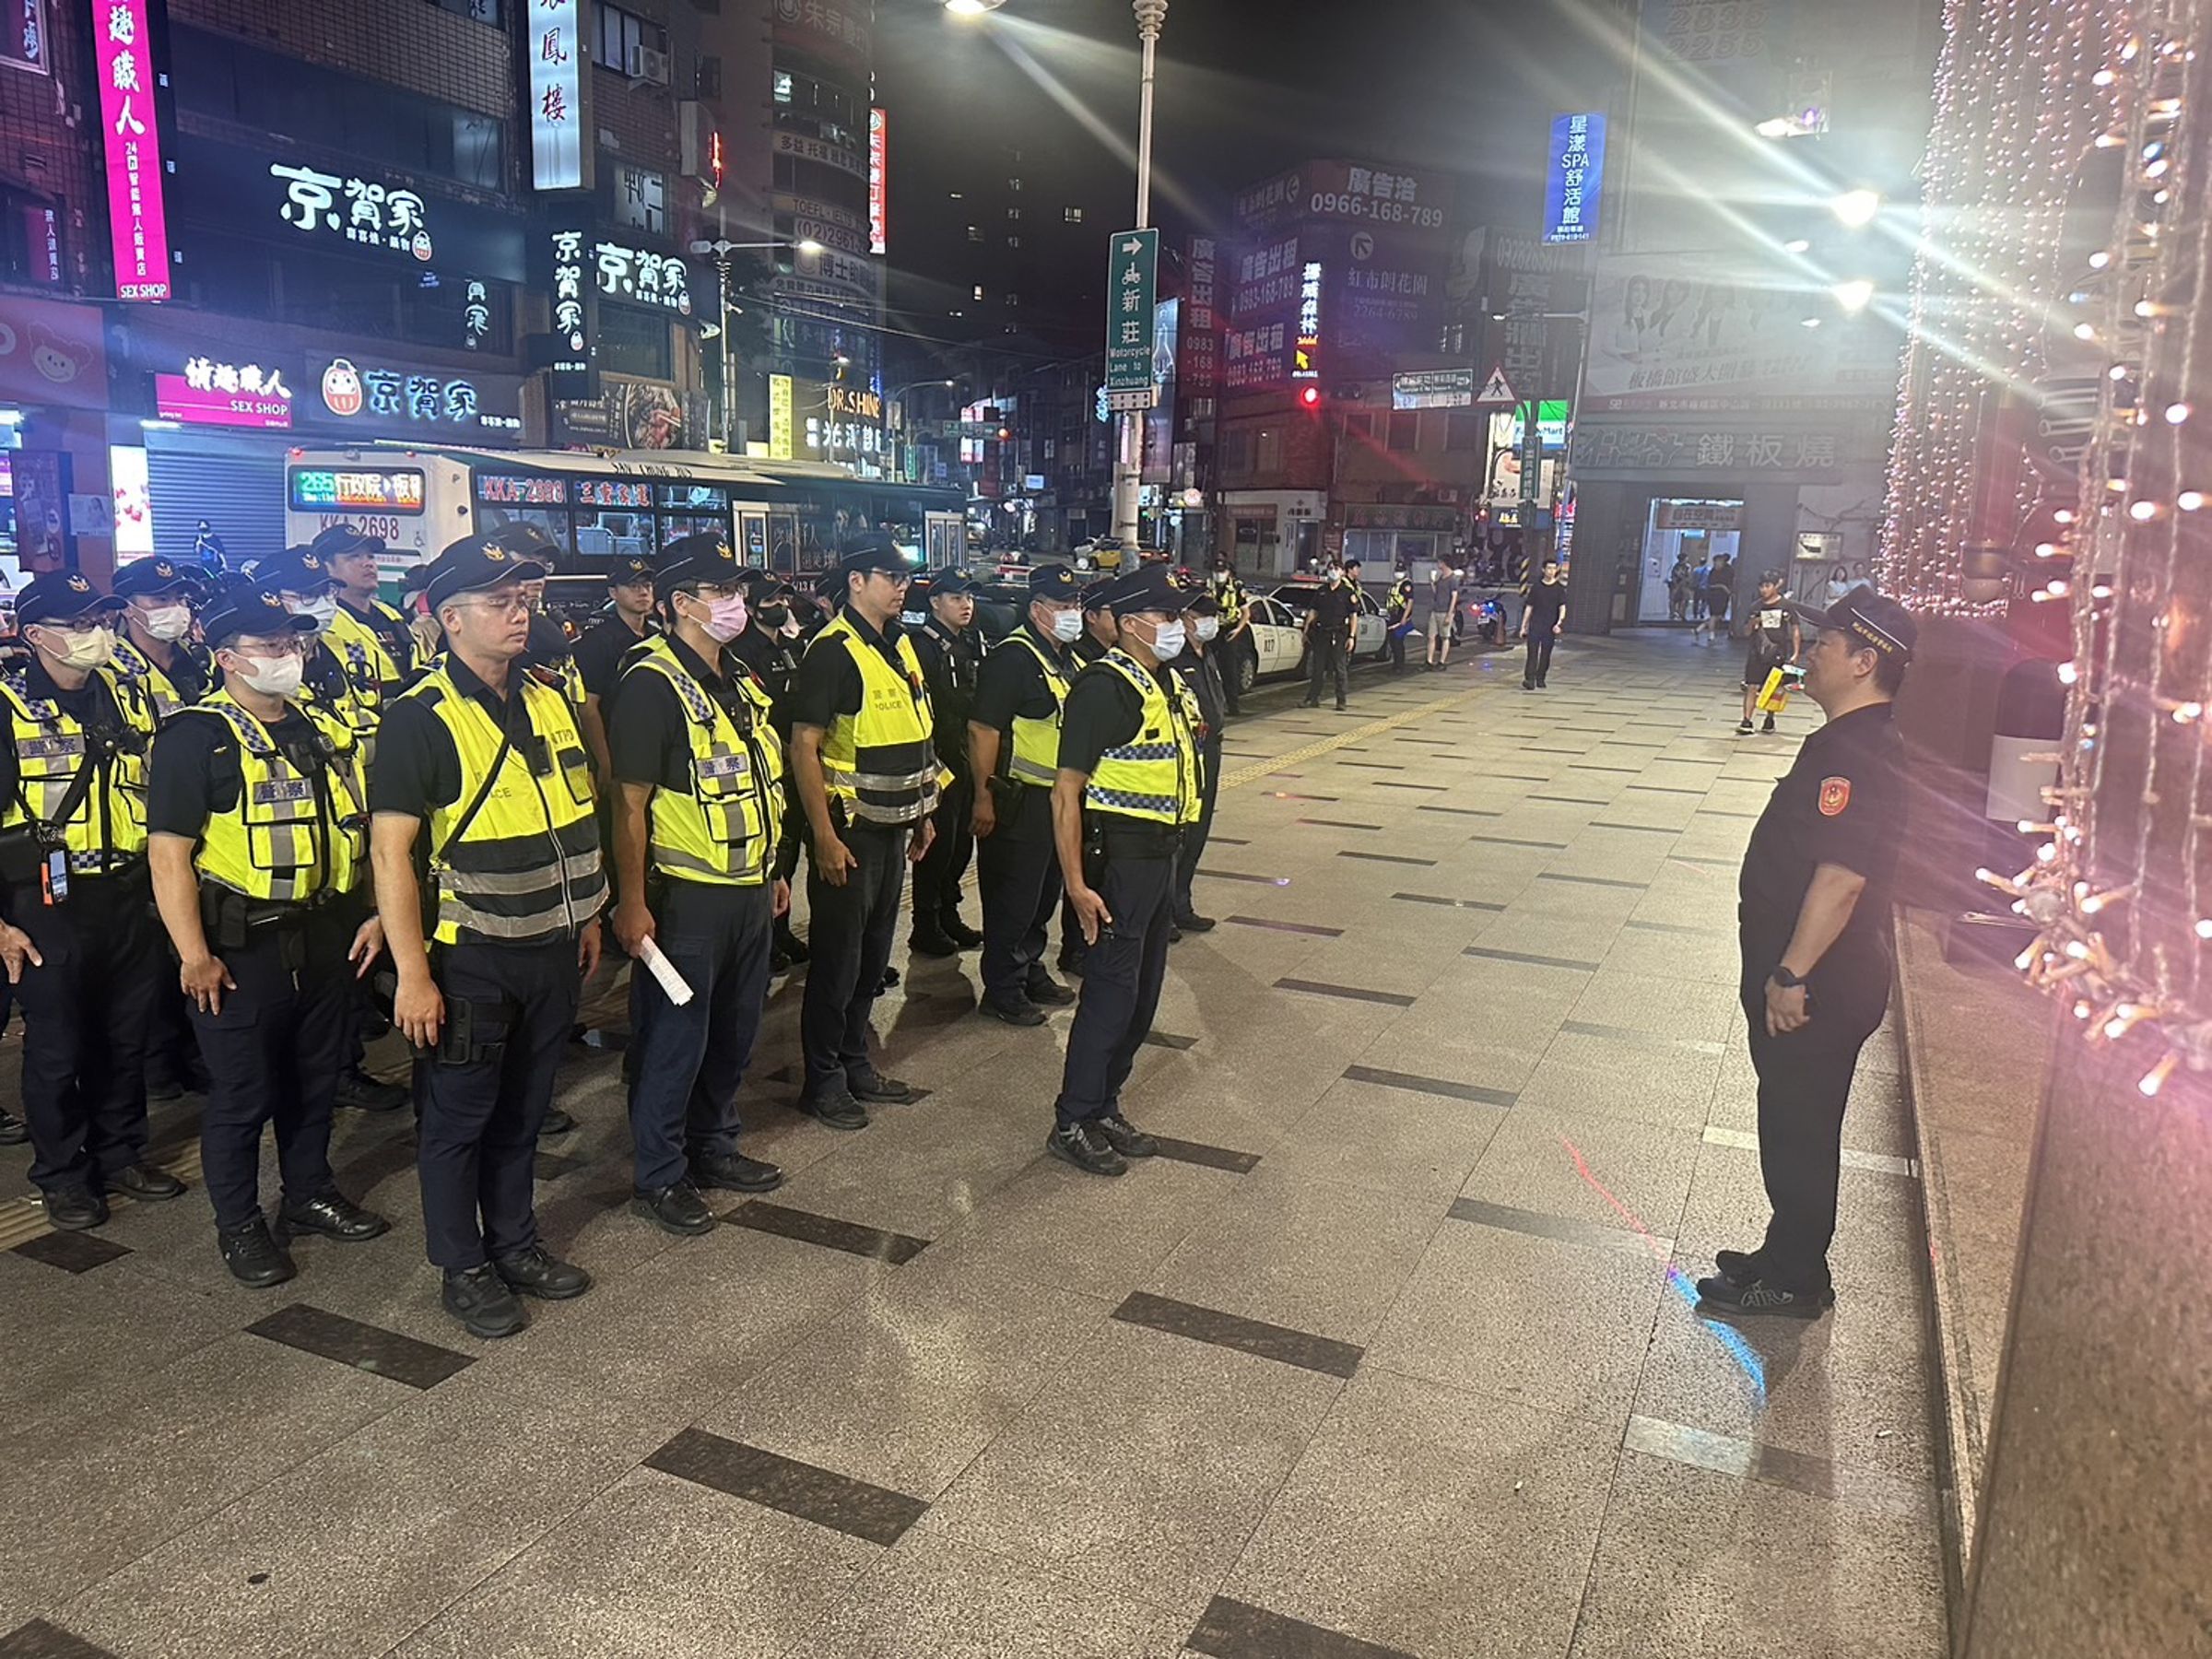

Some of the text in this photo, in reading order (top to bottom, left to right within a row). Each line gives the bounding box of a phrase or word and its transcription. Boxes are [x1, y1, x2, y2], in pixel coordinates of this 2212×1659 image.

[108, 0, 145, 135] 趣職人
[270, 163, 425, 236] 京賀家
[1348, 166, 1418, 203] 廣告洽
[1311, 192, 1443, 229] 0966-168-789
[552, 230, 582, 335] 京賀家
[595, 242, 687, 296] 京賀家
[121, 284, 167, 299] SEX SHOP
[1121, 288, 1142, 345] 新莊
[1109, 346, 1151, 359] Motorcycle
[1109, 362, 1127, 372] Lane
[363, 369, 477, 422] 京賀家
[1109, 375, 1149, 387] Xinzhuang
[230, 400, 288, 416] SEX SHOP
[1514, 425, 1563, 437] FMart
[1696, 433, 1837, 468] 鐵板燒
[299, 472, 335, 492] 265
[261, 782, 305, 799] 警察
